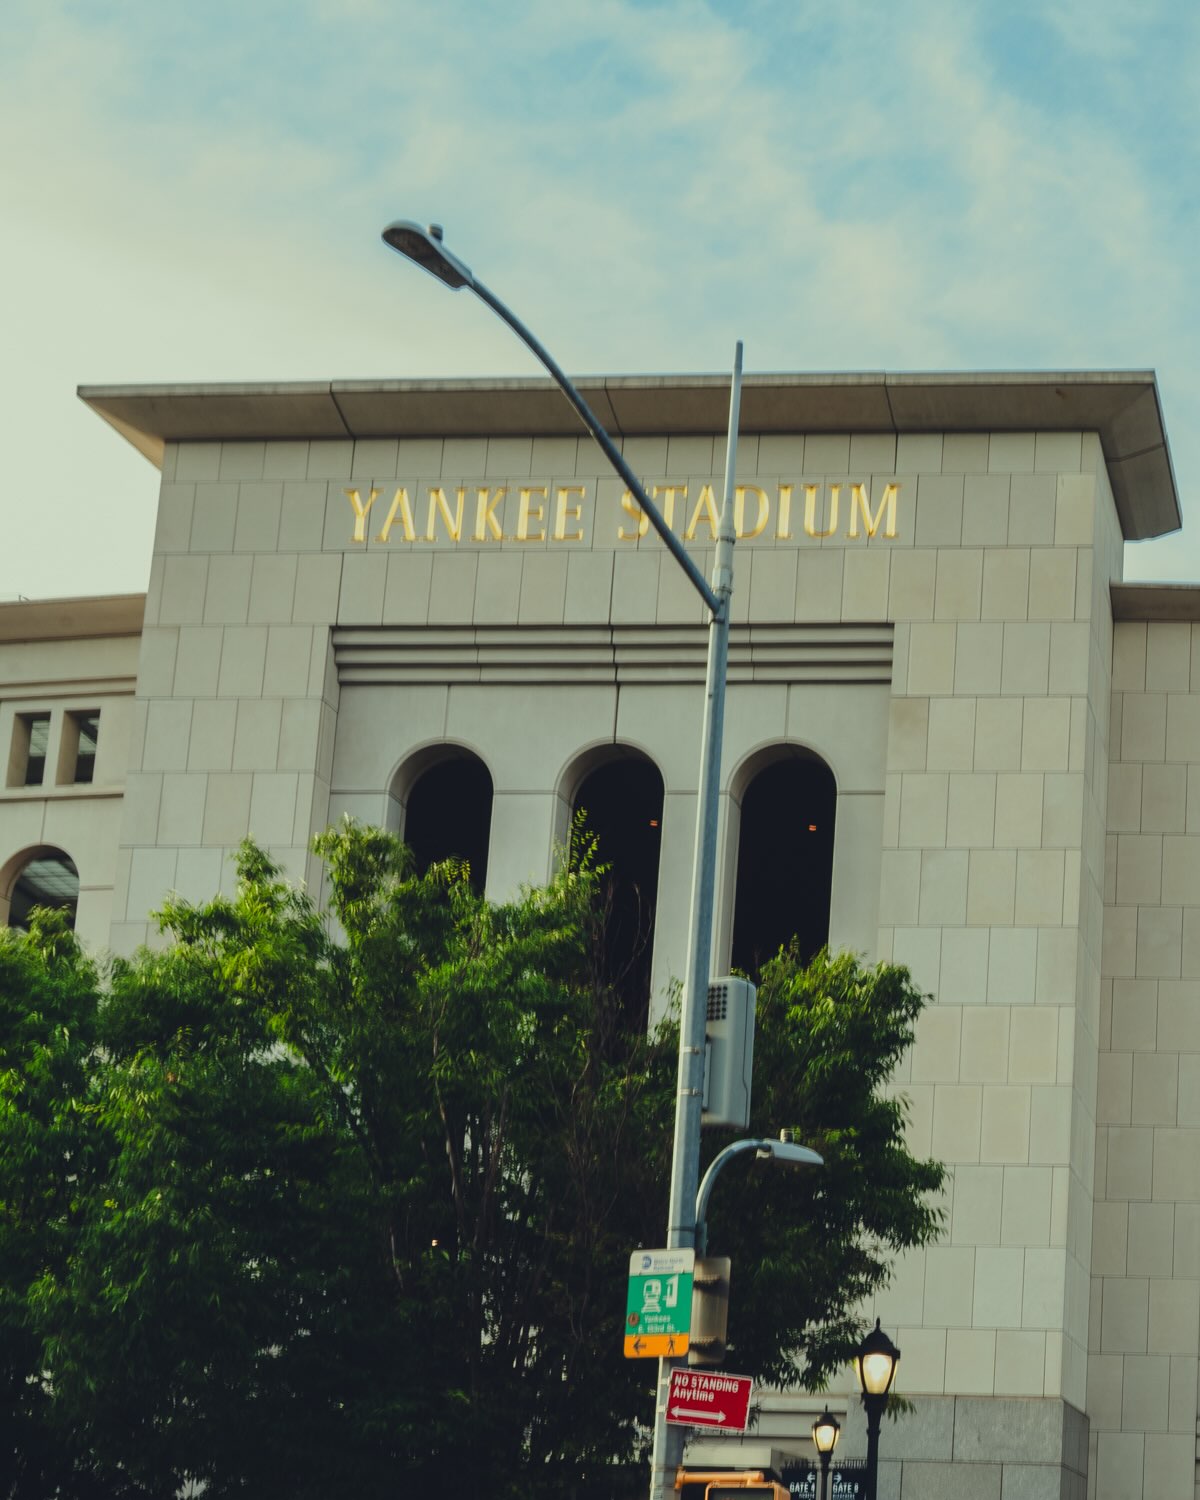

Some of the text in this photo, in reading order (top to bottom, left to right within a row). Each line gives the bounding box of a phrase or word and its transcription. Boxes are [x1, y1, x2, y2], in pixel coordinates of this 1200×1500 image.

[343, 481, 903, 543] YANKEE STADIUM
[674, 1374, 739, 1394] NO STANDING
[672, 1386, 715, 1402] Anytime
[789, 1482, 816, 1493] GATE 4
[832, 1482, 853, 1494] GATE
